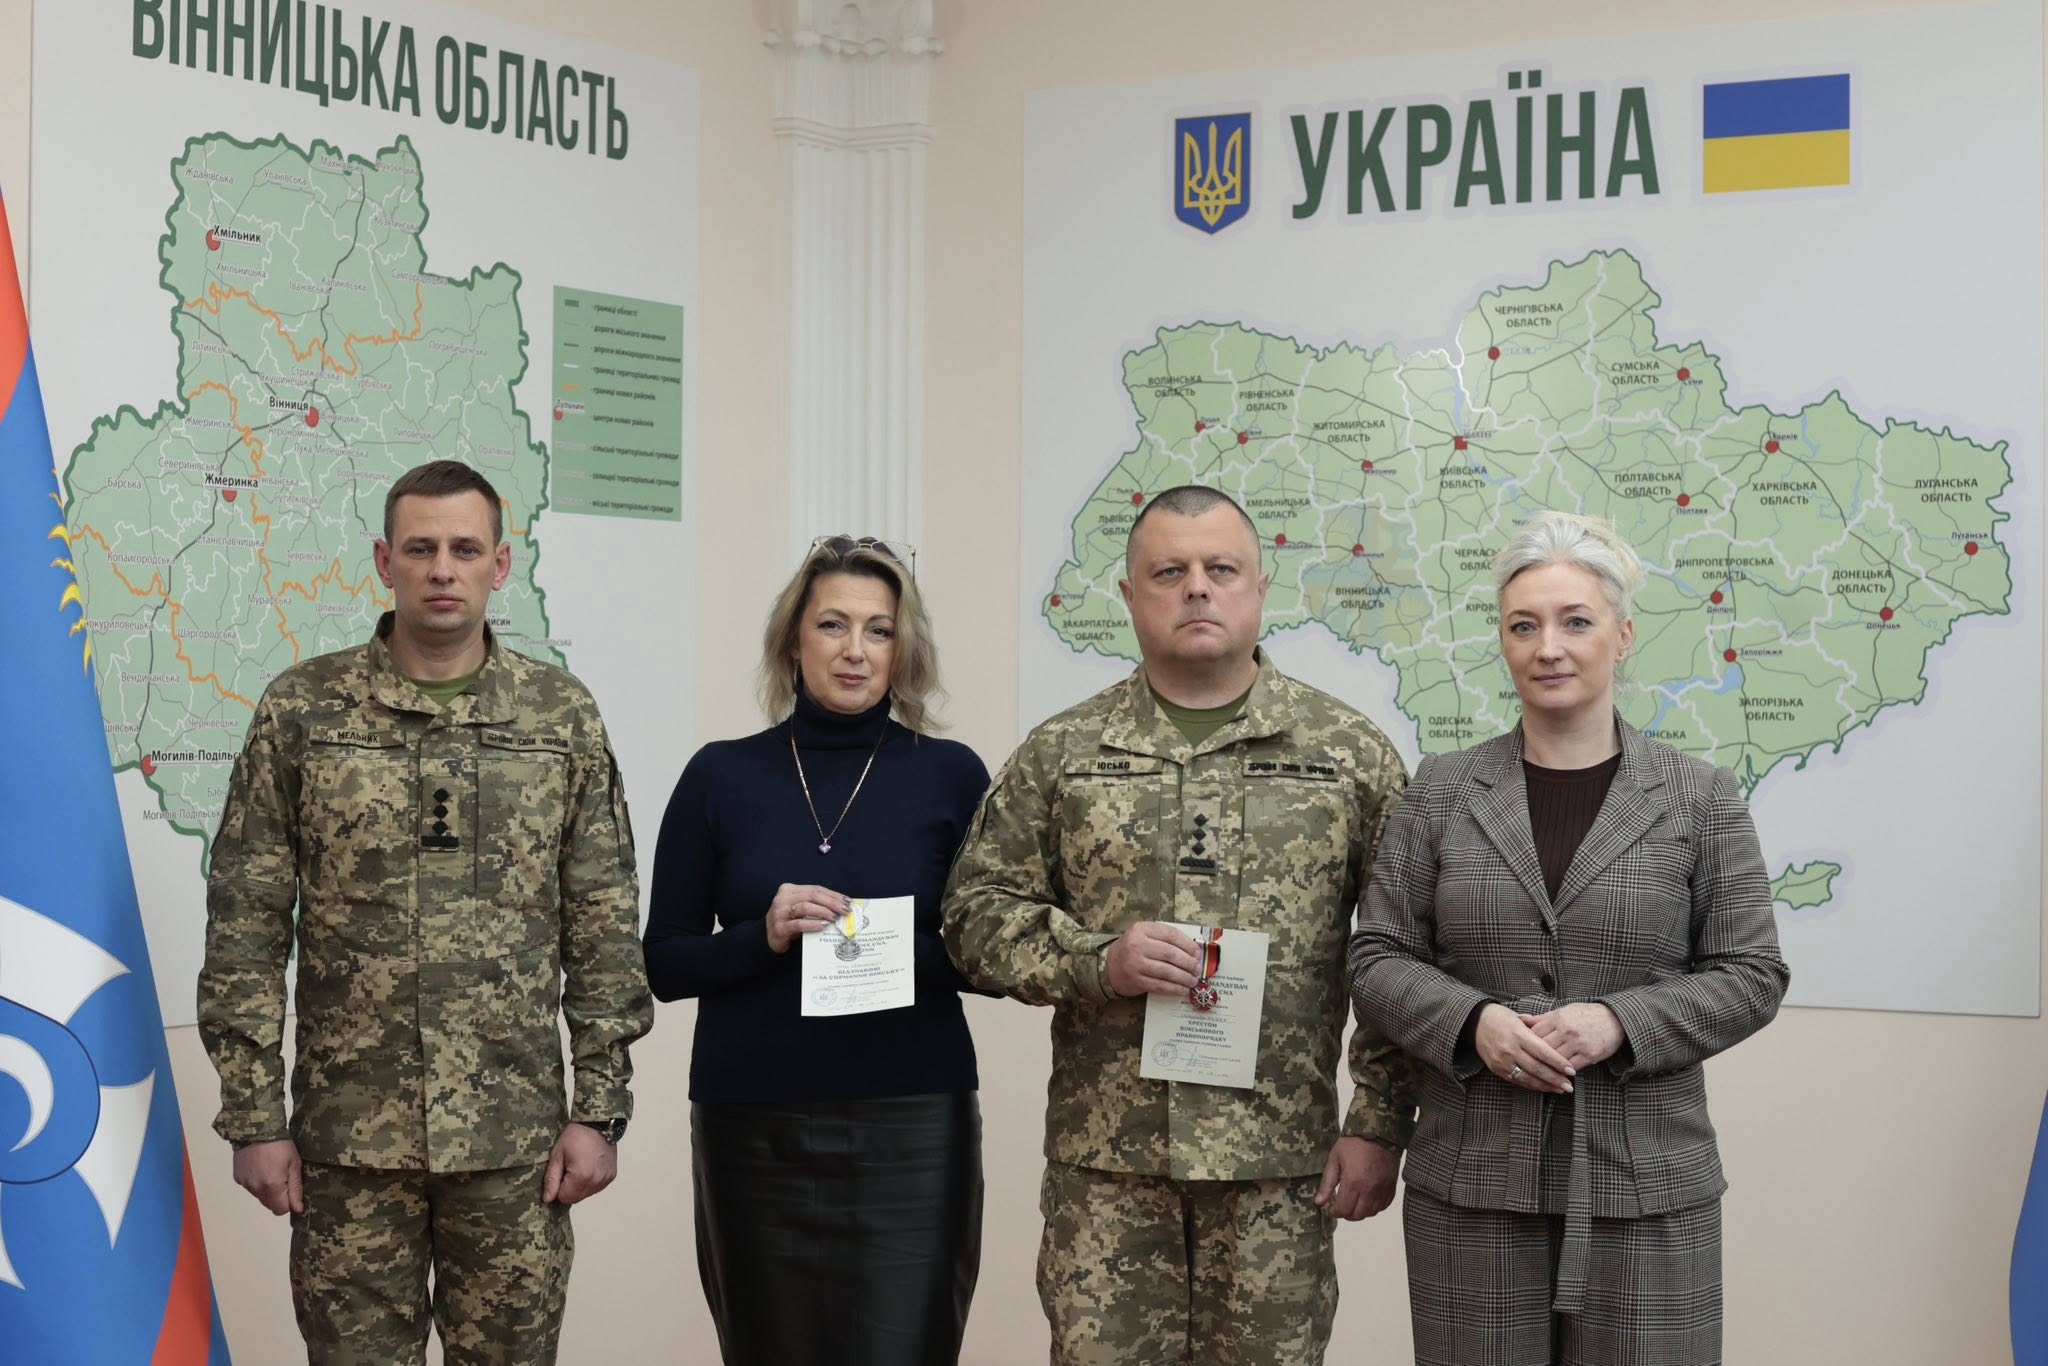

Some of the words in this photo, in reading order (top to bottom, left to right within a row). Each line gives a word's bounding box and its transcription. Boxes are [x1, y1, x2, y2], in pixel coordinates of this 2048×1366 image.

[132, 0, 421, 116] ВІННИЦЬКА
[435, 35, 629, 161] ОБЛАСТЬ
[1290, 69, 1660, 220] УКРАЇНА
[185, 167, 234, 184] Жданівська
[264, 168, 307, 186] Уланівська
[213, 225, 262, 243] Хмільник
[216, 262, 267, 280] Хмільницька
[1494, 303, 1564, 315] ЧЕРНІГІВСЬКА
[1506, 317, 1552, 328] ОБЛАСТЬ
[192, 340, 232, 355] Літинська
[1611, 360, 1660, 372] СУМСЬКА
[1148, 375, 1202, 386] ВОЛИНСЬКА
[1612, 376, 1659, 386] ОБЛАСТЬ
[1155, 388, 1196, 398] ОБЛАСТЬ
[1239, 389, 1295, 400] РІВНЕНСЬКА
[269, 396, 309, 411] Вінниця
[1246, 402, 1288, 412] ОБЛАСТЬ
[185, 417, 236, 430] Жмеринська
[1312, 419, 1386, 431] ЖИТОМИРСЬКА
[1328, 433, 1371, 444] ОБЛАСТЬ
[158, 456, 221, 473] Северинівська
[1440, 465, 1487, 476] КИЇВСЬКА
[204, 472, 259, 488] Жмеринка
[1615, 471, 1682, 483] ПОЛТАВСЬКА
[107, 476, 142, 491] Барська
[1440, 480, 1486, 489] ОБЛАСТЬ
[1752, 481, 1817, 493] ХАРКІВСЬКА
[1915, 477, 1978, 490] ЛУГАНСЬКА
[1624, 486, 1671, 497] ОБЛАСТЬ
[1246, 497, 1311, 508] ХМЕЛЬНИЦЬКА
[1760, 494, 1809, 506] ОБЛАСТЬ
[1920, 492, 1972, 504] ОБЛАСТЬ
[1098, 514, 1138, 524] ЛЬВІВСЬ
[1258, 510, 1298, 520] ОБЛАСТЬ
[1102, 528, 1132, 537] ОБЛАС
[1460, 561, 1492, 572] ОБЛАС
[1675, 557, 1775, 569] ДНІПРОПЕТРОВСЬКА
[1702, 571, 1747, 580] ОБЛАСТЬ
[1832, 569, 1892, 581] ДОНЕЦЬКА
[1335, 586, 1391, 597] ВІННИЦЬКА
[1837, 583, 1887, 593] ОБЛАСТЬ
[1340, 599, 1385, 610] ОБЛАСТЬ
[1062, 619, 1128, 629] ЗАКАРПАТСЬКА
[177, 628, 237, 641] Шаргородська
[1075, 633, 1115, 641] ОБЛАСТЬ
[121, 672, 180, 684] Вендичанська
[1738, 697, 1804, 708] ЗАПОРІЗЬКА
[1428, 715, 1473, 726] ОДЕСЬКА
[1746, 711, 1795, 721] ОБЛАСТЬ
[337, 731, 380, 744] МЕЛЬНИК
[1428, 729, 1473, 739] ОБЛАСТЬ
[1644, 729, 1687, 740] ОНСЬКА
[1097, 761, 1131, 771] ЮСЬКО
